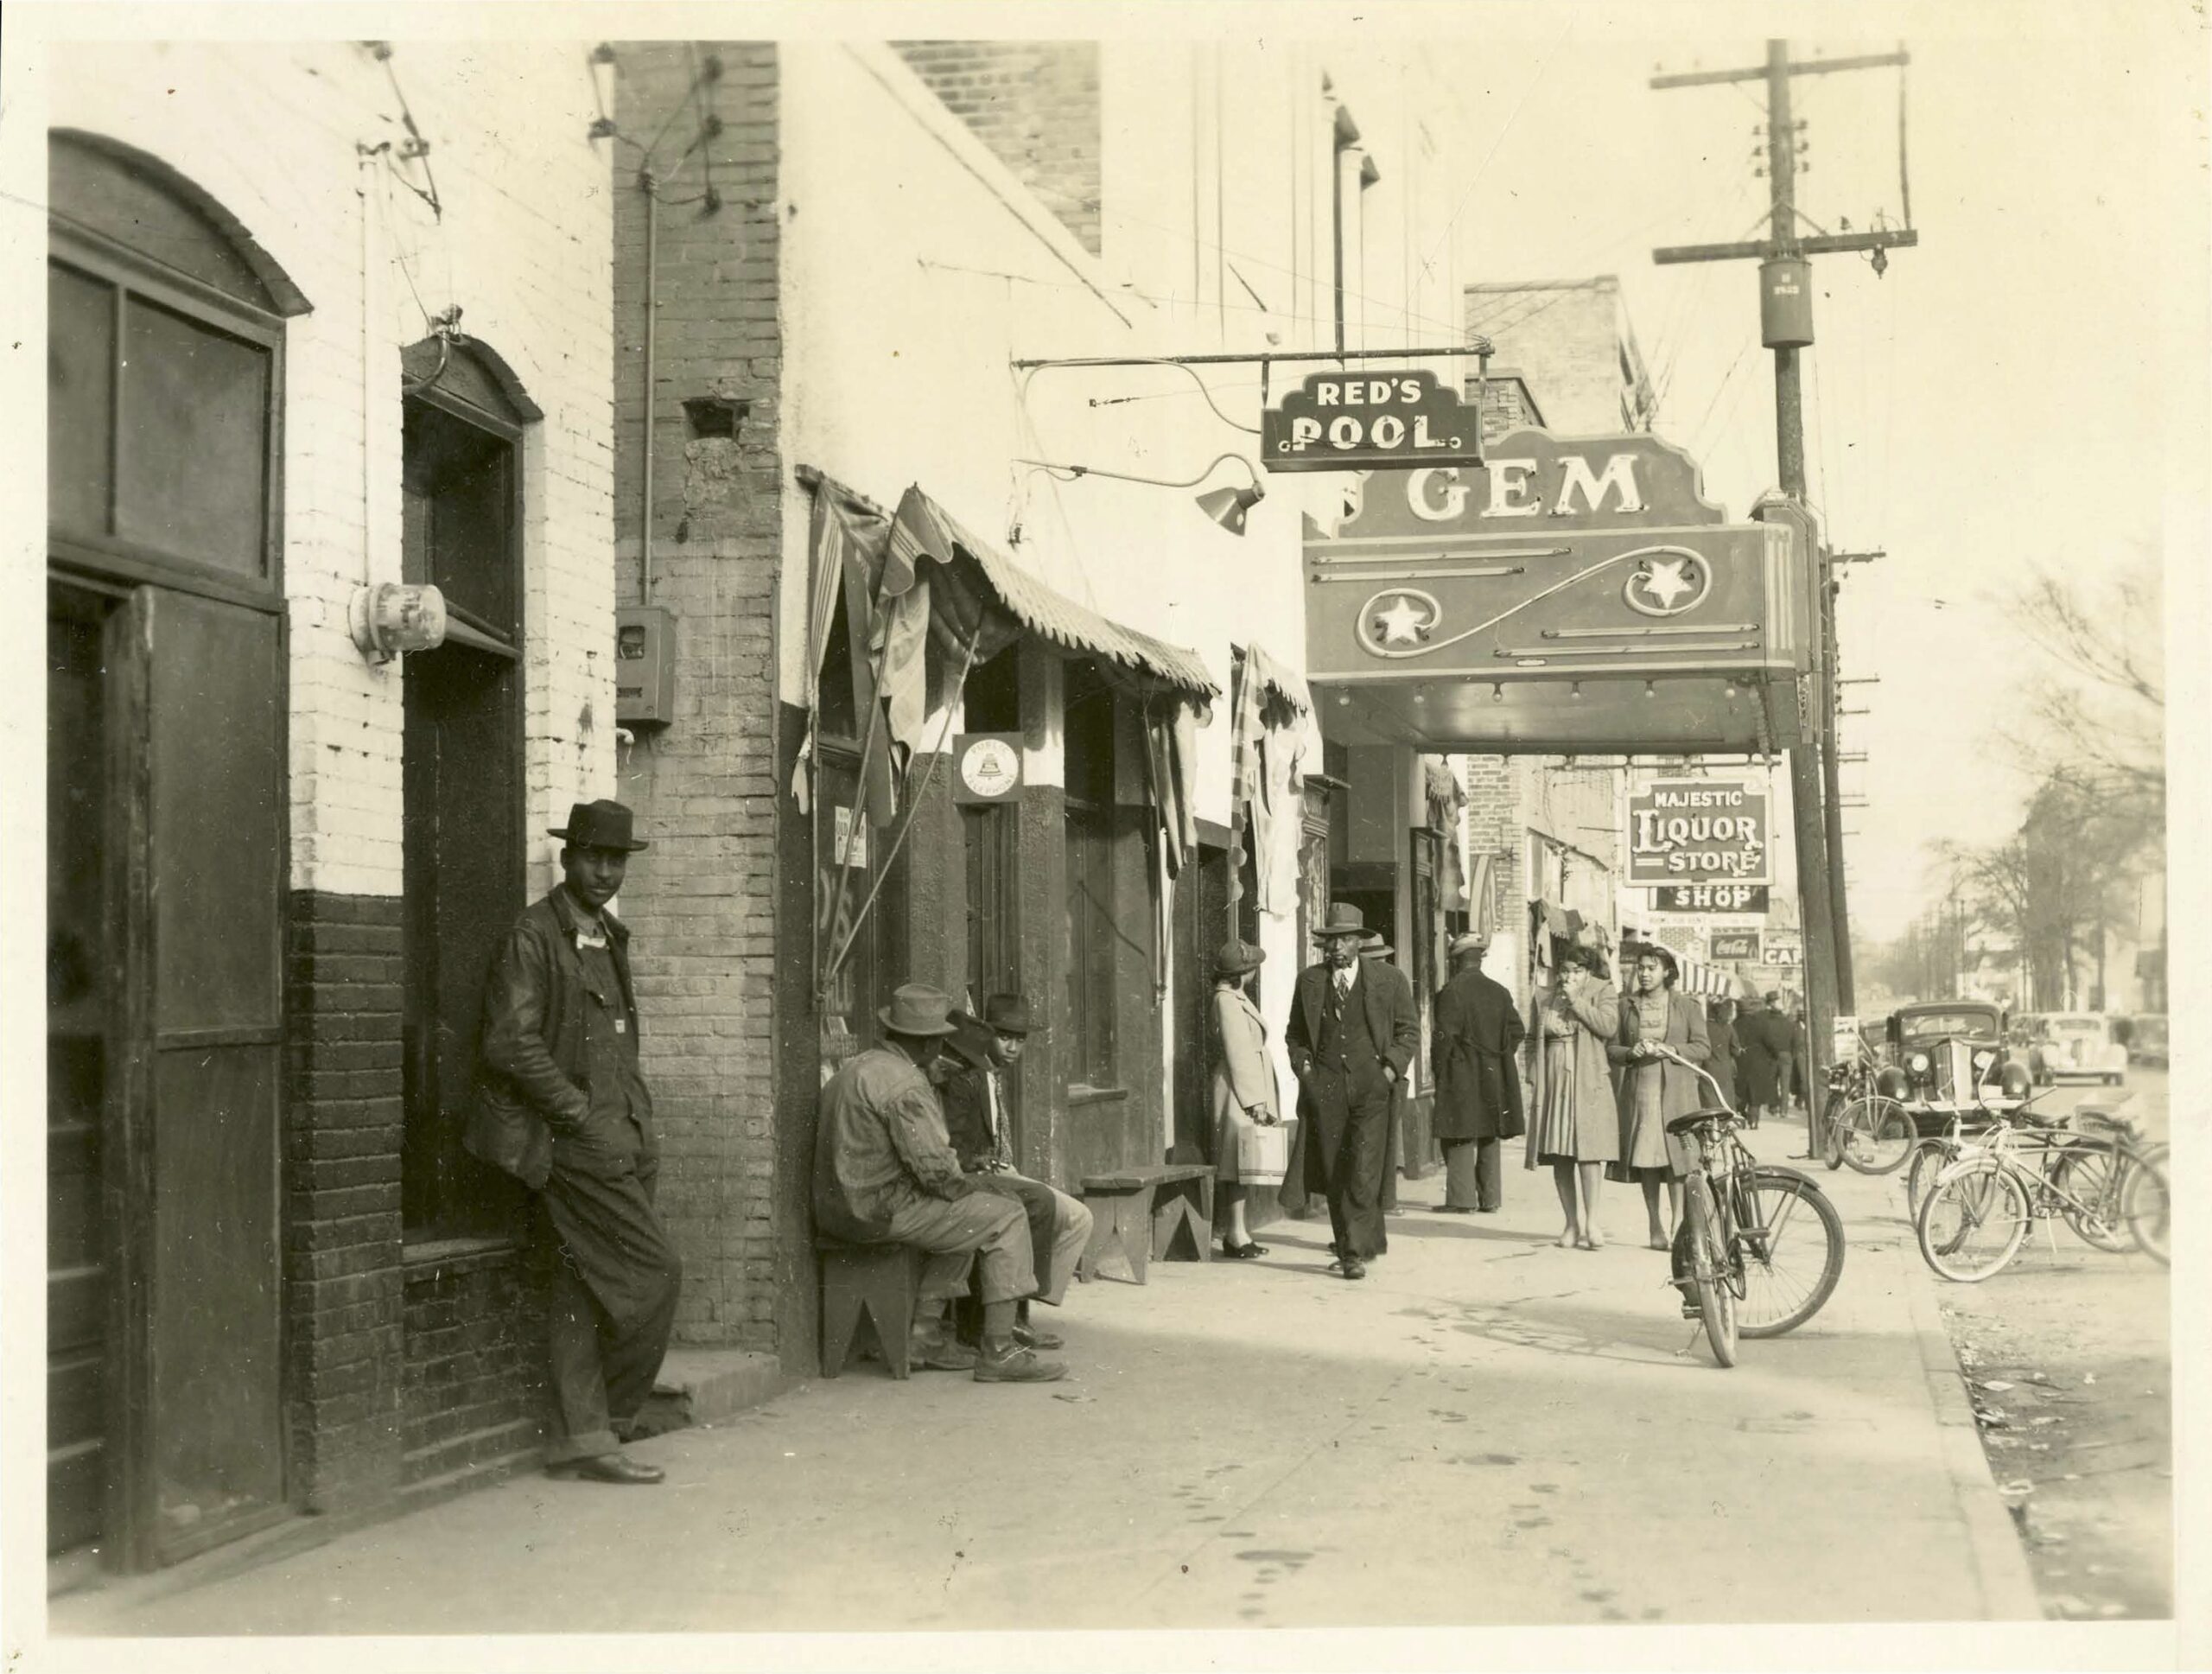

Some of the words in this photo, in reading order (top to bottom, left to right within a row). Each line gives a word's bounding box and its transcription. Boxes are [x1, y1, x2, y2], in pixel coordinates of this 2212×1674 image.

[1317, 378, 1421, 405] RED'S
[1292, 415, 1446, 450] POOL
[1407, 454, 1646, 521] GEM
[1655, 790, 1743, 808] MAJESTIC
[1631, 808, 1764, 853] LIQUOR
[1669, 850, 1761, 878] STORE
[1675, 889, 1751, 908] SHOP
